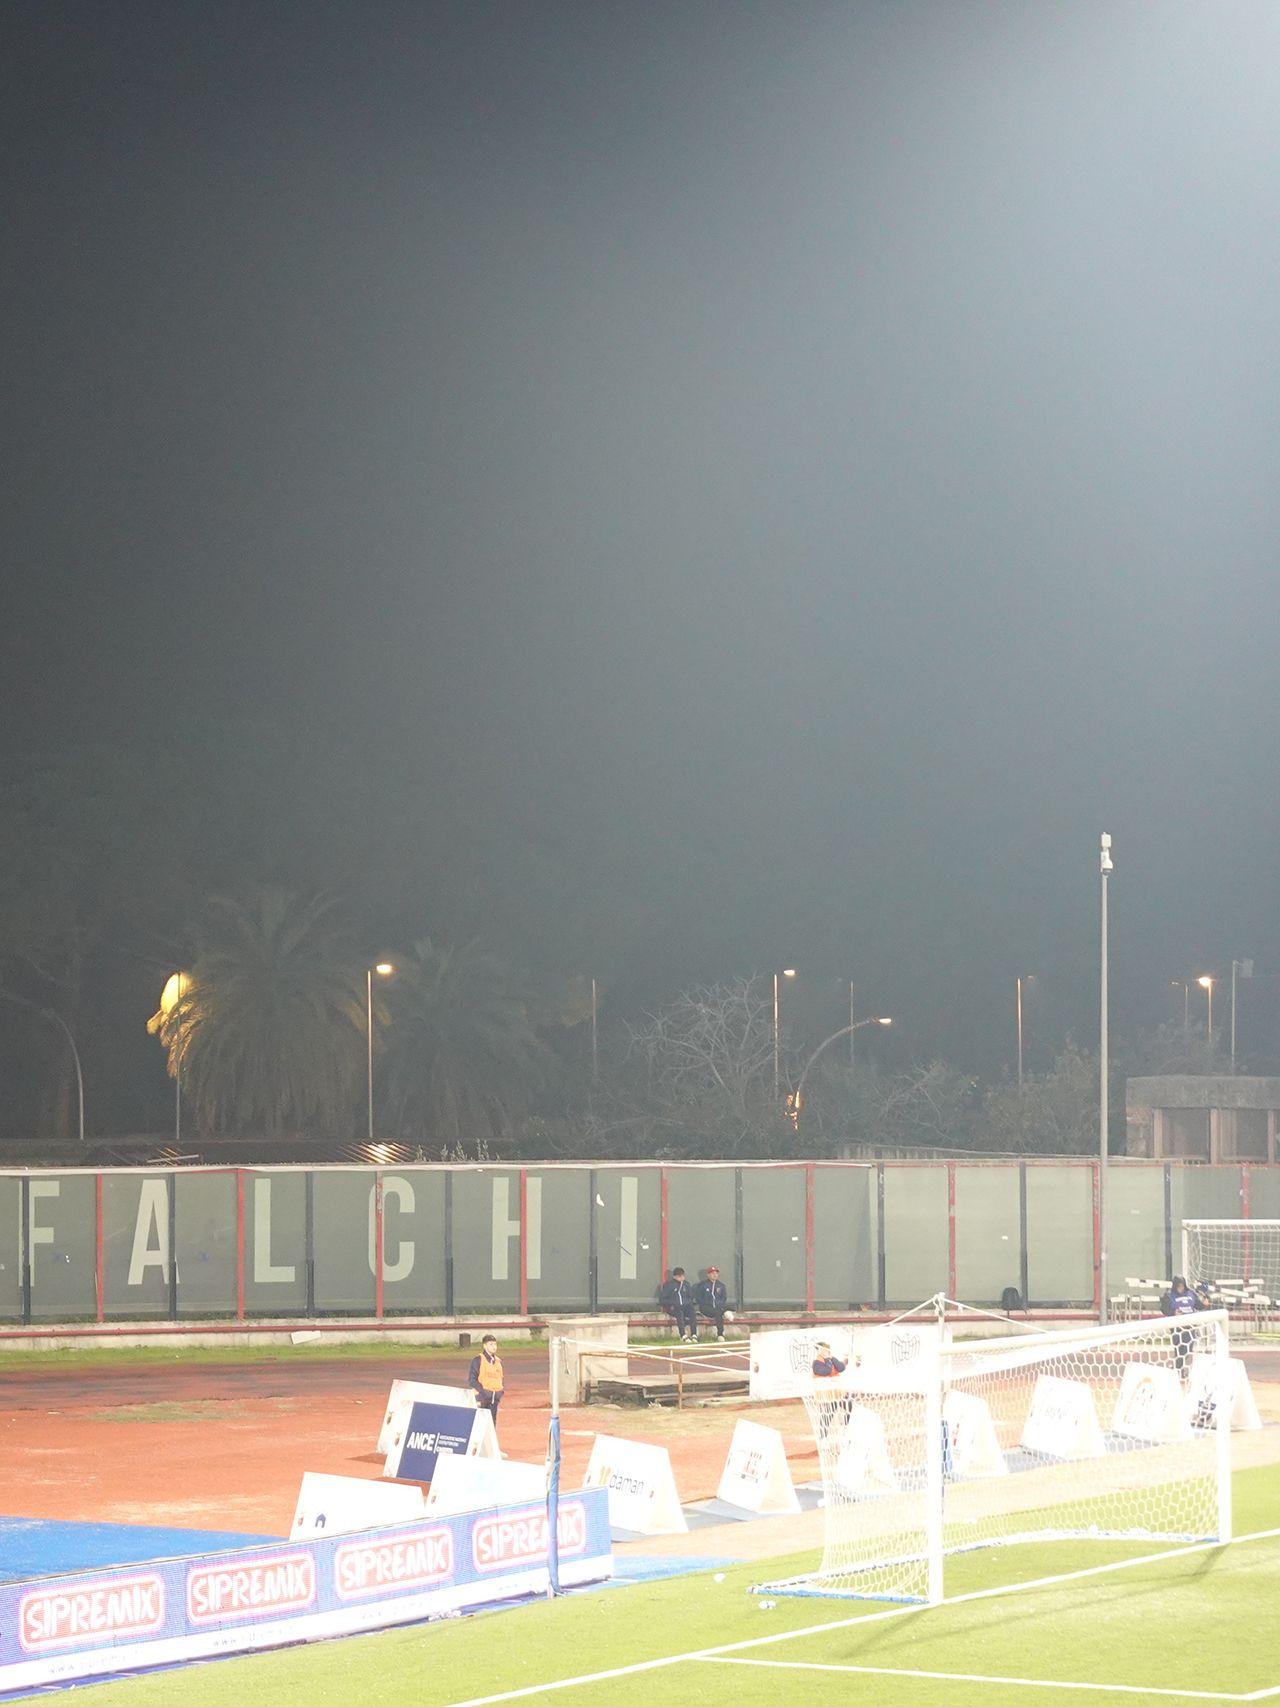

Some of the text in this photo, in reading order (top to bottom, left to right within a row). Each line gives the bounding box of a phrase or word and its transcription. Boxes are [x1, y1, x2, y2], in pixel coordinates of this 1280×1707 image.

[19, 1177, 638, 1288] FALCHI
[407, 1432, 436, 1451] ANCE
[192, 1559, 306, 1613] SIPREMIX
[339, 1535, 448, 1588] SIPREMIX
[27, 1582, 158, 1640] SIPREMIX
